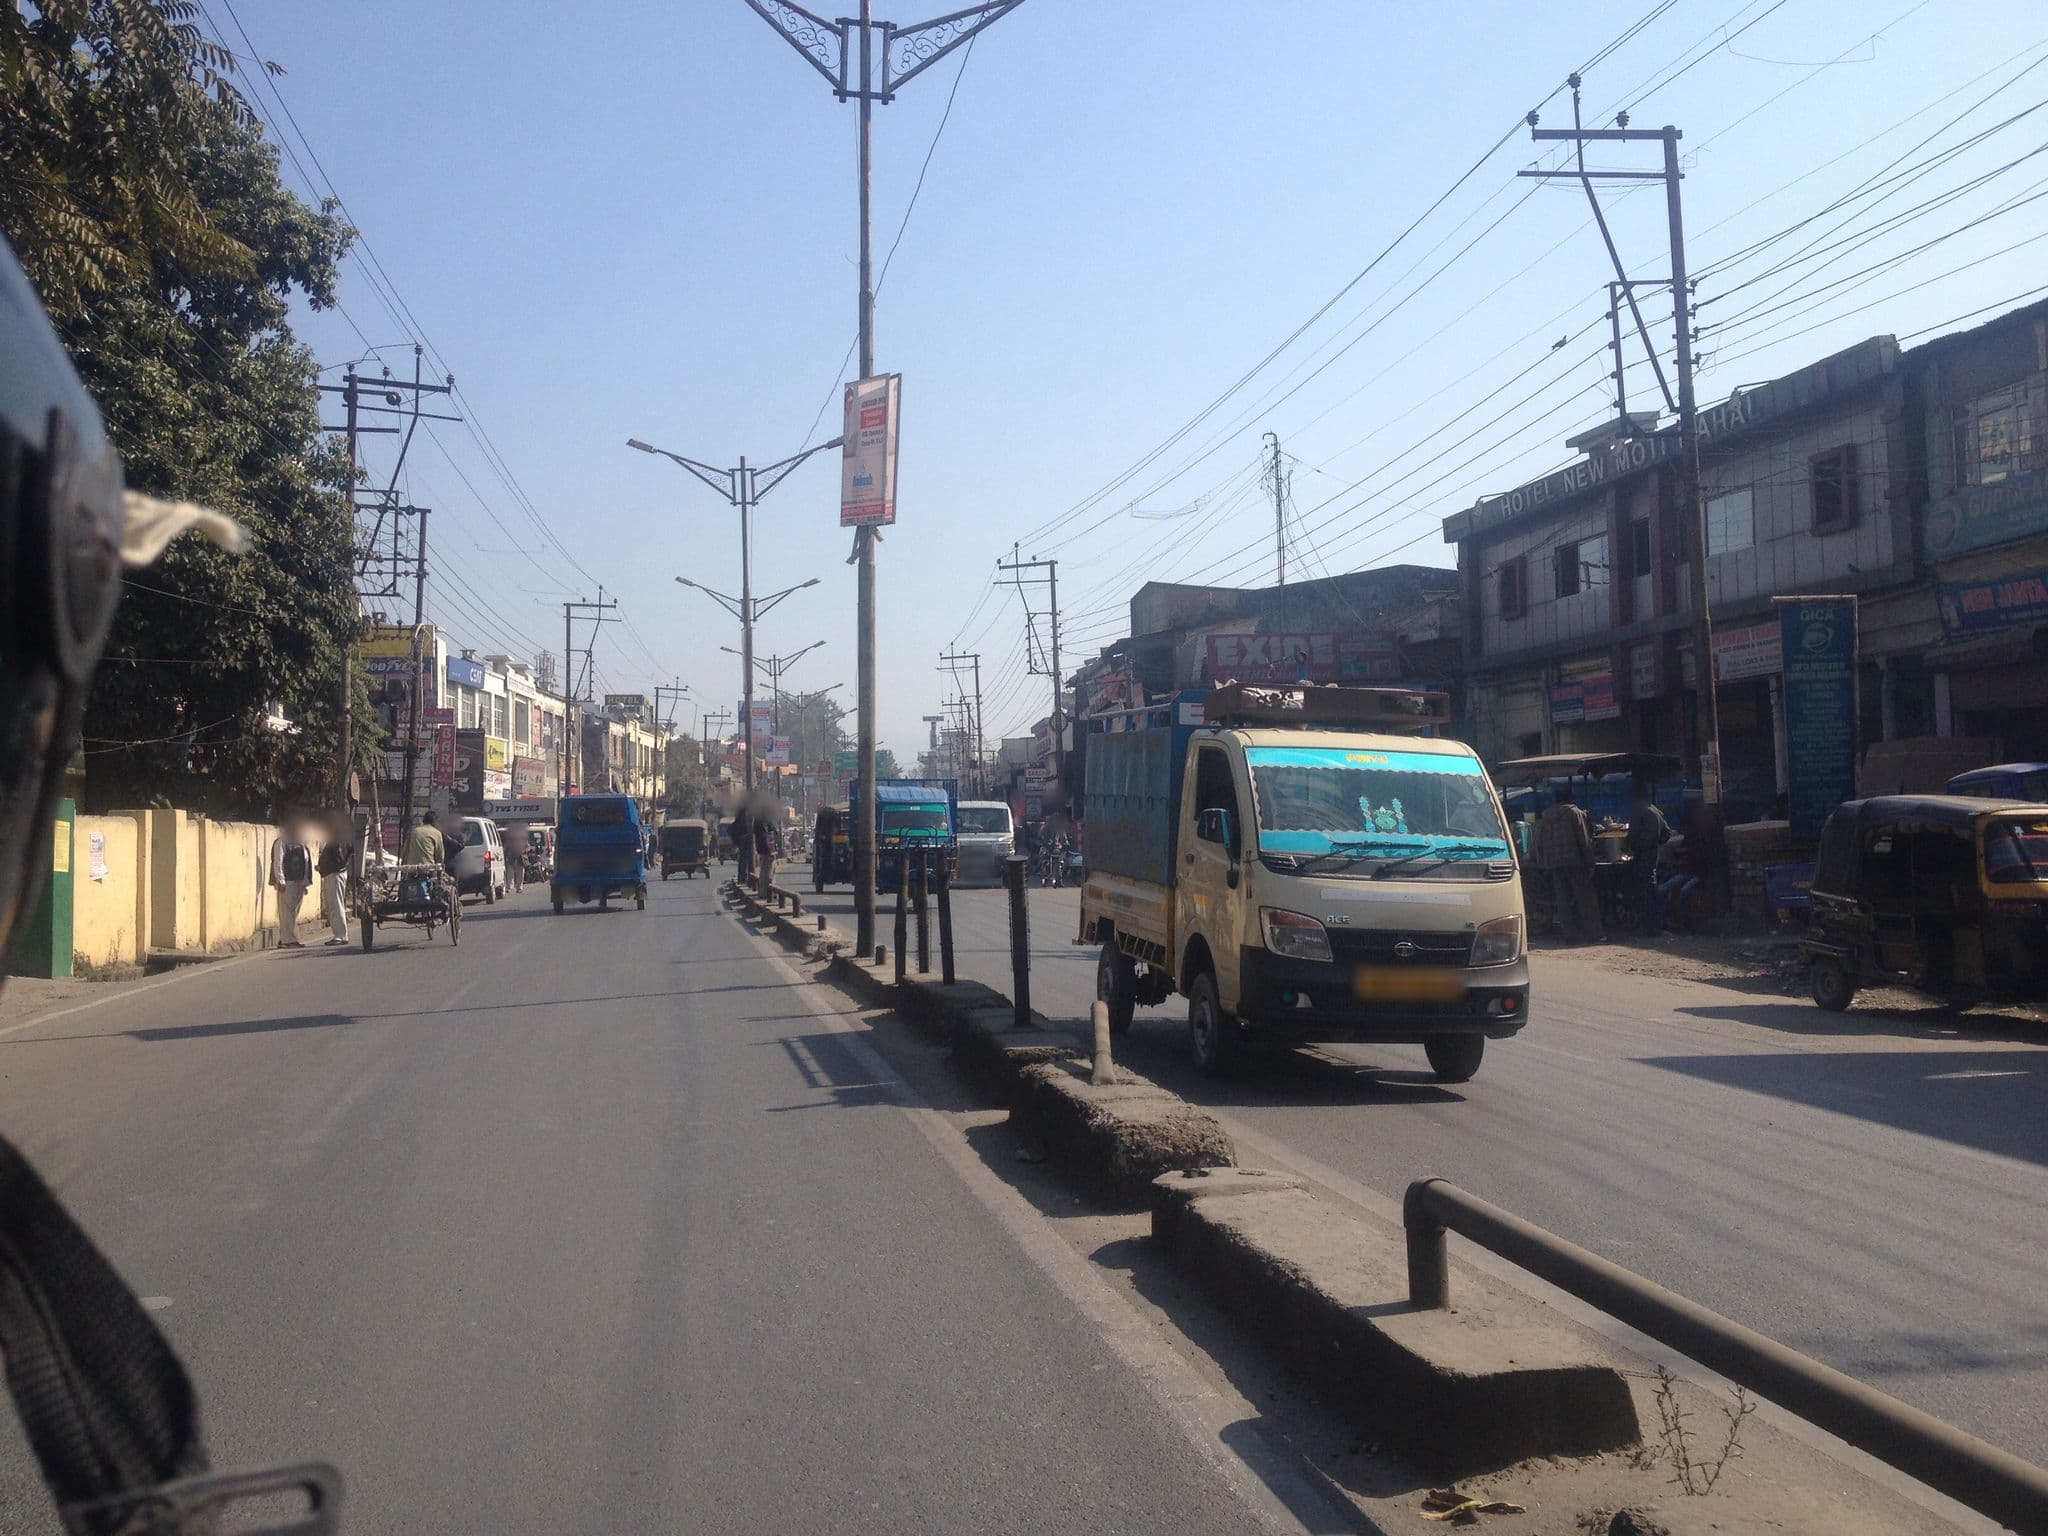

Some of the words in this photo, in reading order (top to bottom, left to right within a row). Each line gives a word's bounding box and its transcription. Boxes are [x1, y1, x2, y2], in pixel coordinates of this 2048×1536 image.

[1499, 480, 1550, 517] HOTEL
[1562, 456, 1604, 493] NEW
[1216, 635, 1335, 665] EXIDE
[513, 804, 541, 812] TYRES
[1326, 914, 1351, 926] ACE
